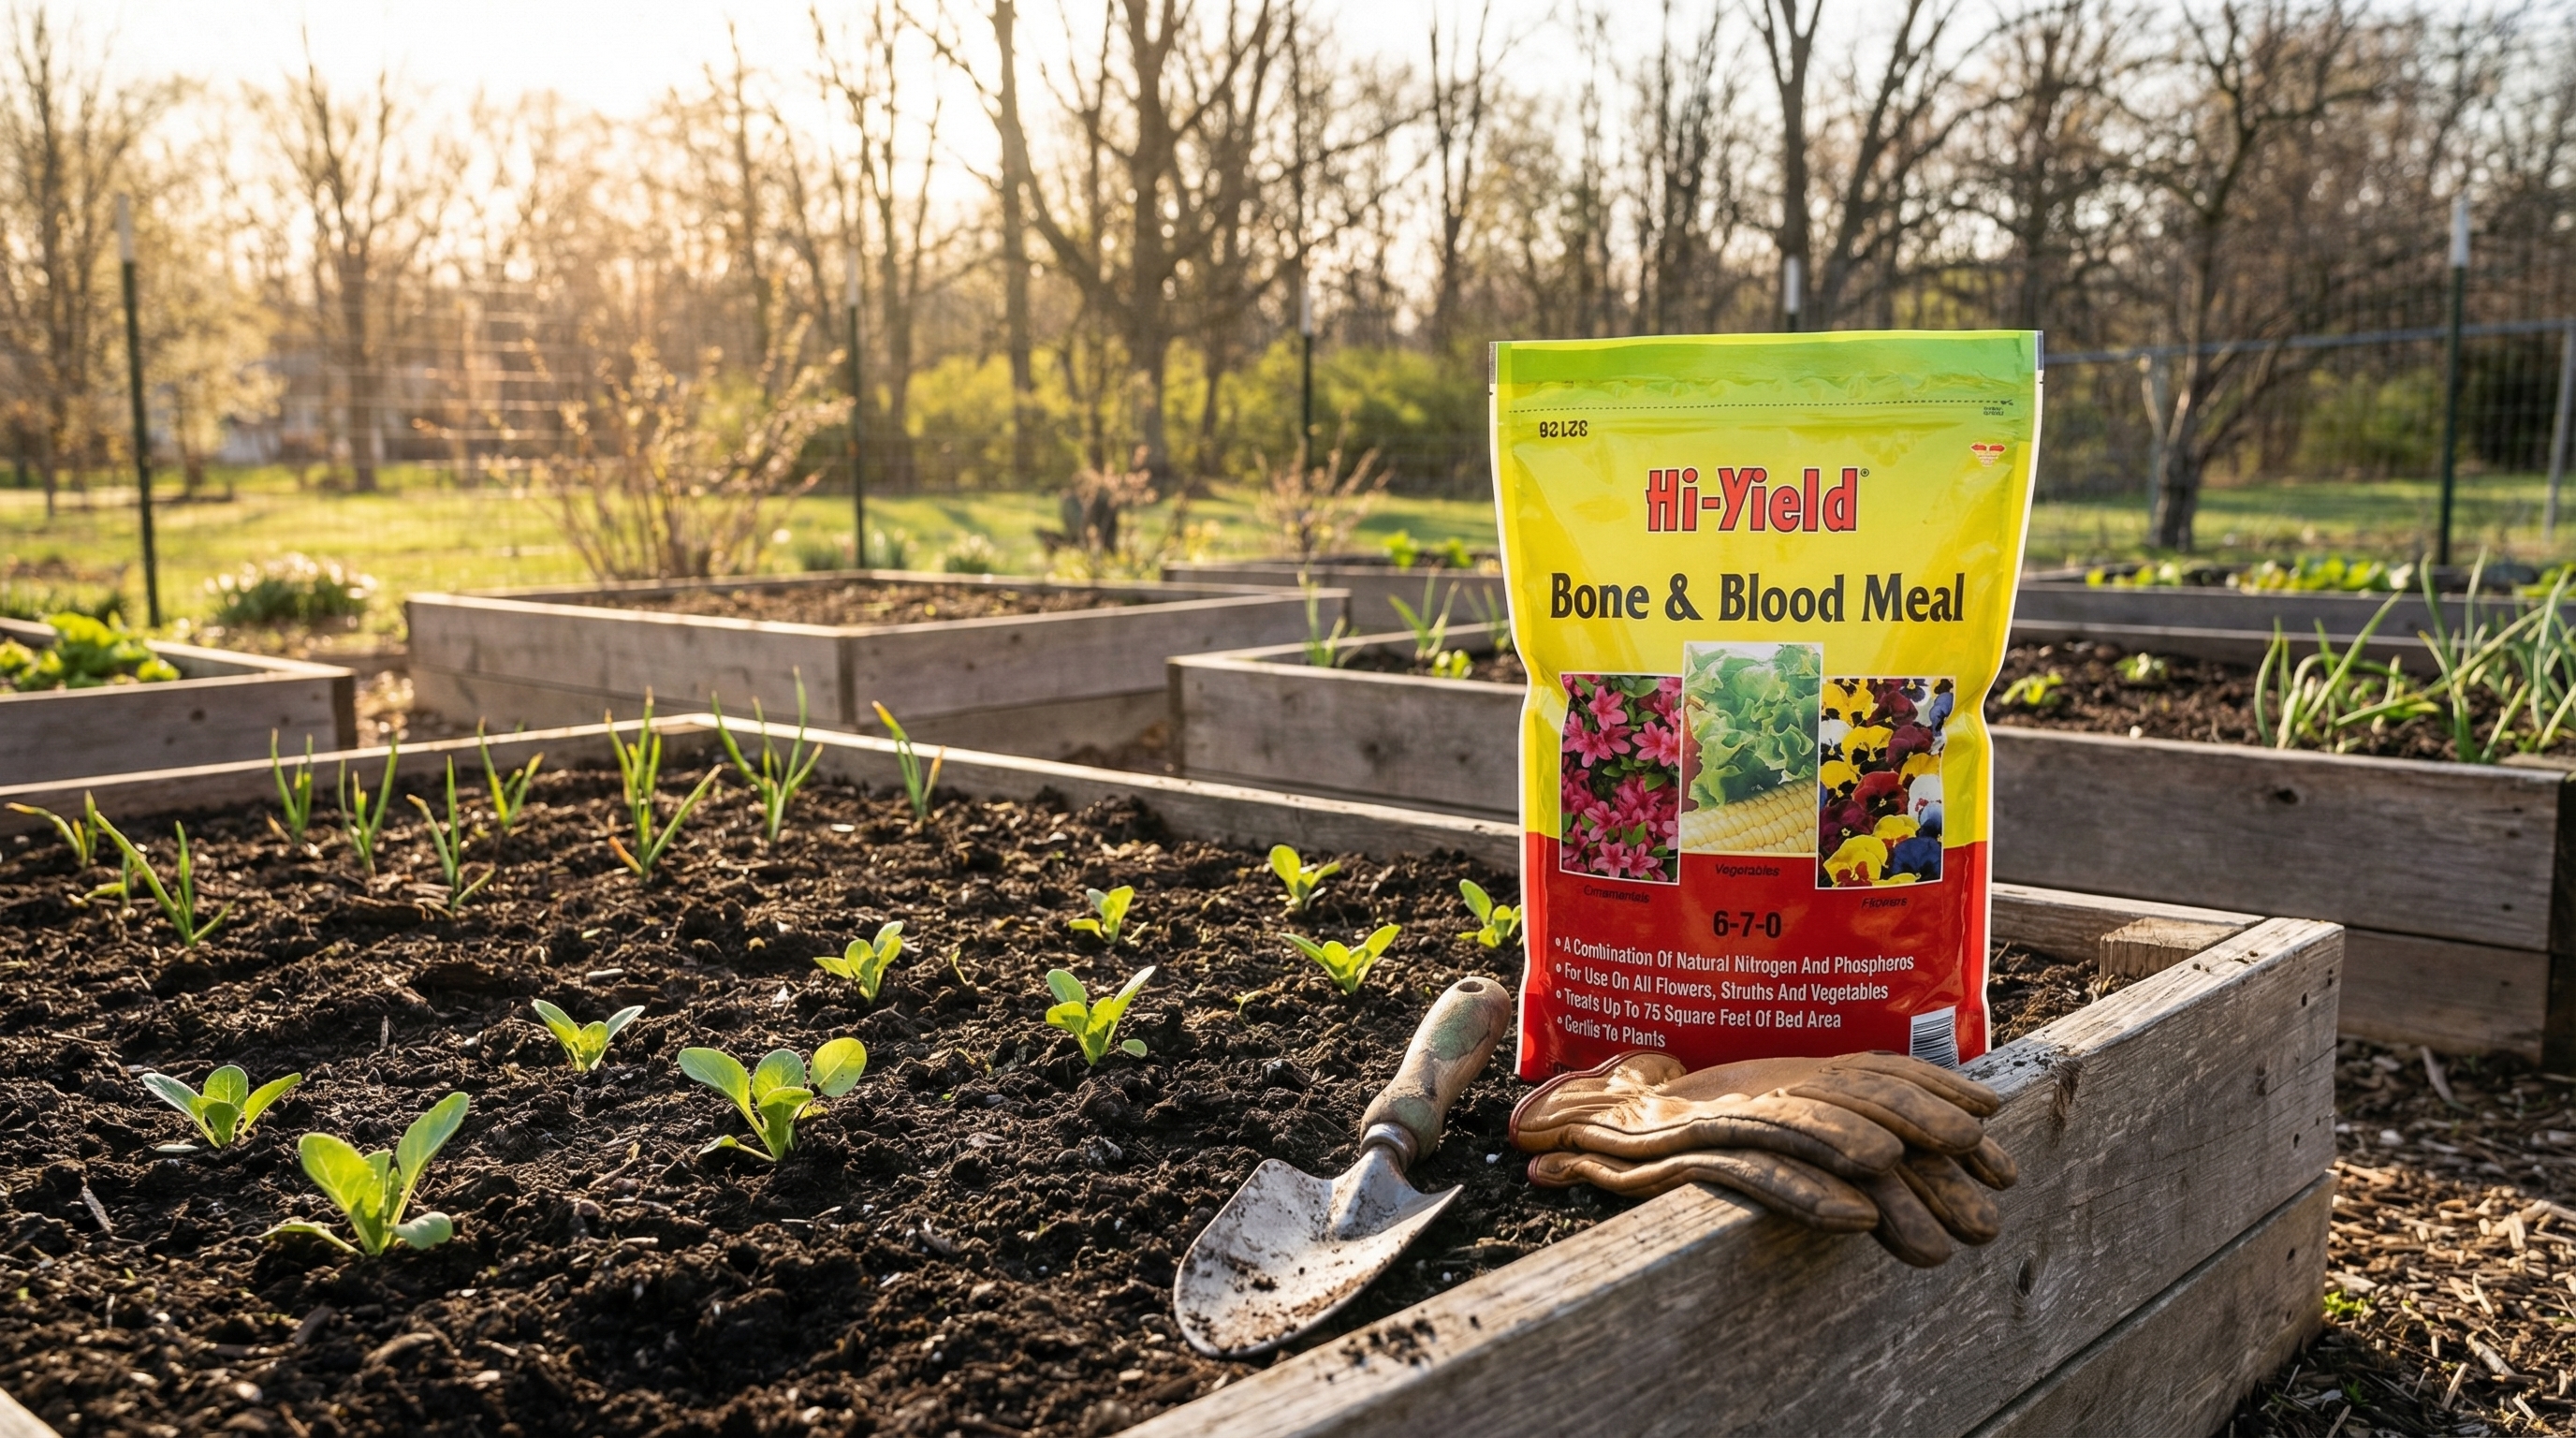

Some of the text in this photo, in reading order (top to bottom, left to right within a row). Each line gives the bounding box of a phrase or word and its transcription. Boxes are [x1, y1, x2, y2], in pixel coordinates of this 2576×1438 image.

[1550, 572, 1965, 623] Bone & Blood Meal
[1713, 909, 1782, 939] 6-7-0
[1563, 936, 1914, 978] A Combination Of Natural Nitrogen And Phospheros
[1564, 961, 1889, 1005] For Use On All Flowers, Struths And Vegetables
[1603, 996, 1621, 1020] Up
[1624, 999, 1640, 1019] To
[1644, 1002, 1661, 1021] 75
[1664, 1004, 1716, 1028] Square
[1720, 1008, 1751, 1027] Feet
[1755, 1009, 1772, 1028] Of
[1775, 1010, 1803, 1029] Bed
[1807, 1010, 1841, 1029] Area
[1622, 1025, 1666, 1049] Plants
